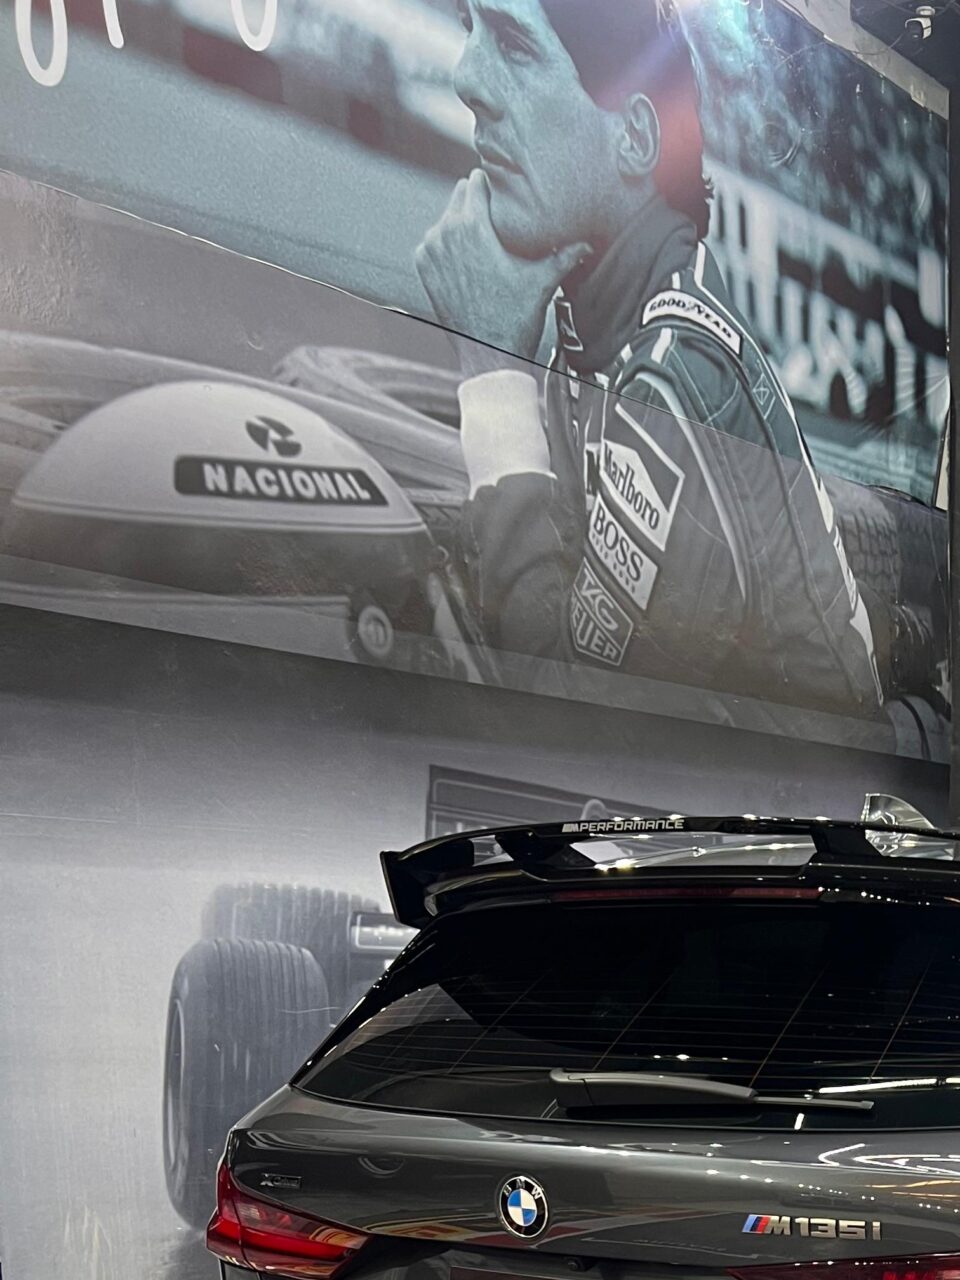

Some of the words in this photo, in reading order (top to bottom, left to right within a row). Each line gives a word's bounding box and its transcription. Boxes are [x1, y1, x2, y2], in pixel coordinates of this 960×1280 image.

[649, 298, 732, 338] GOODYEAR
[203, 463, 371, 500] NACIONAL
[604, 442, 660, 530] Marlboro
[593, 503, 643, 582] BOSS
[581, 567, 619, 631] TAG
[580, 819, 685, 832] PERFORMANCE
[503, 1178, 543, 1200] BMW
